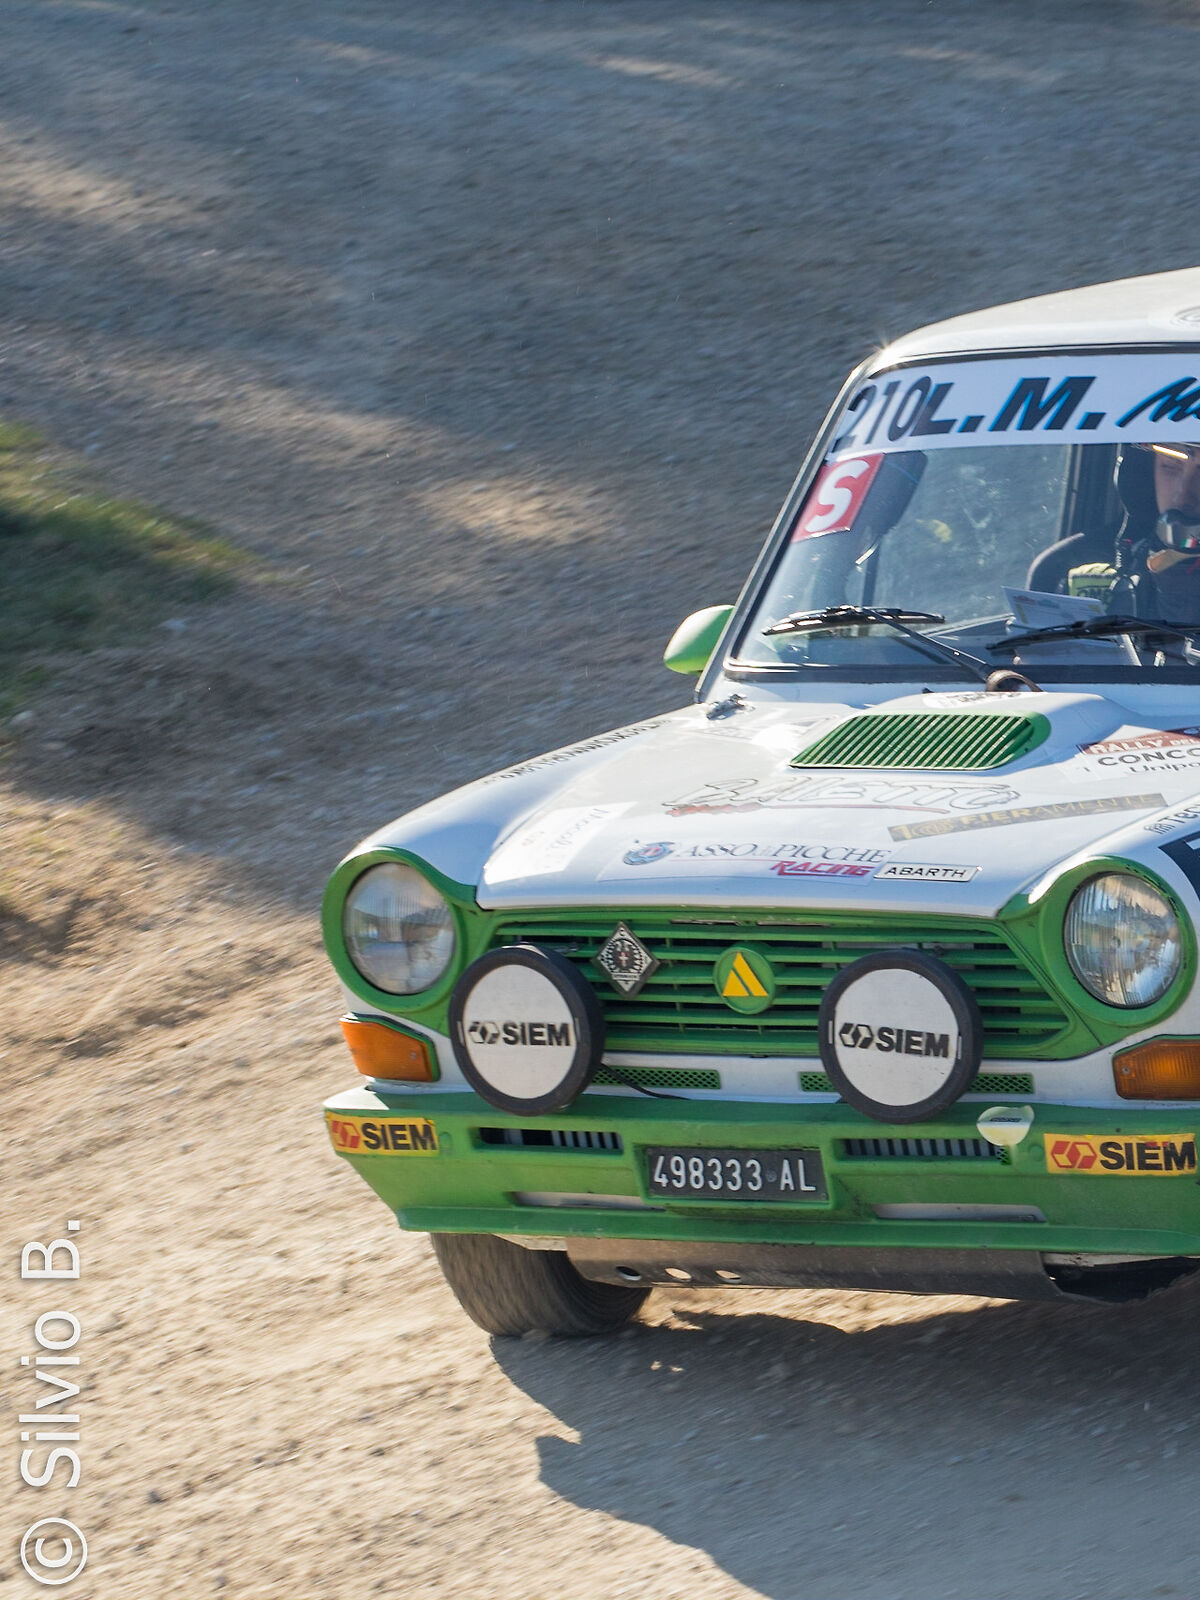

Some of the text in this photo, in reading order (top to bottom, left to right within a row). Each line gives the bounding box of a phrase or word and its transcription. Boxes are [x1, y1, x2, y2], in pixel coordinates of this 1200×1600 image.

[832, 375, 932, 453] 210
[909, 375, 1107, 437] L.M.
[801, 457, 870, 533] S
[1090, 739, 1166, 753] RALLY
[678, 842, 760, 857] ASSO
[772, 843, 893, 863] PICCHE
[769, 860, 876, 877] RACING
[884, 866, 967, 880] ABARTH
[501, 1019, 572, 1047] SIEM
[875, 1026, 950, 1058] SIEM
[361, 1121, 438, 1152] SIEM
[1099, 1140, 1197, 1171] SIEM
[653, 1155, 817, 1192] 498333 AL
